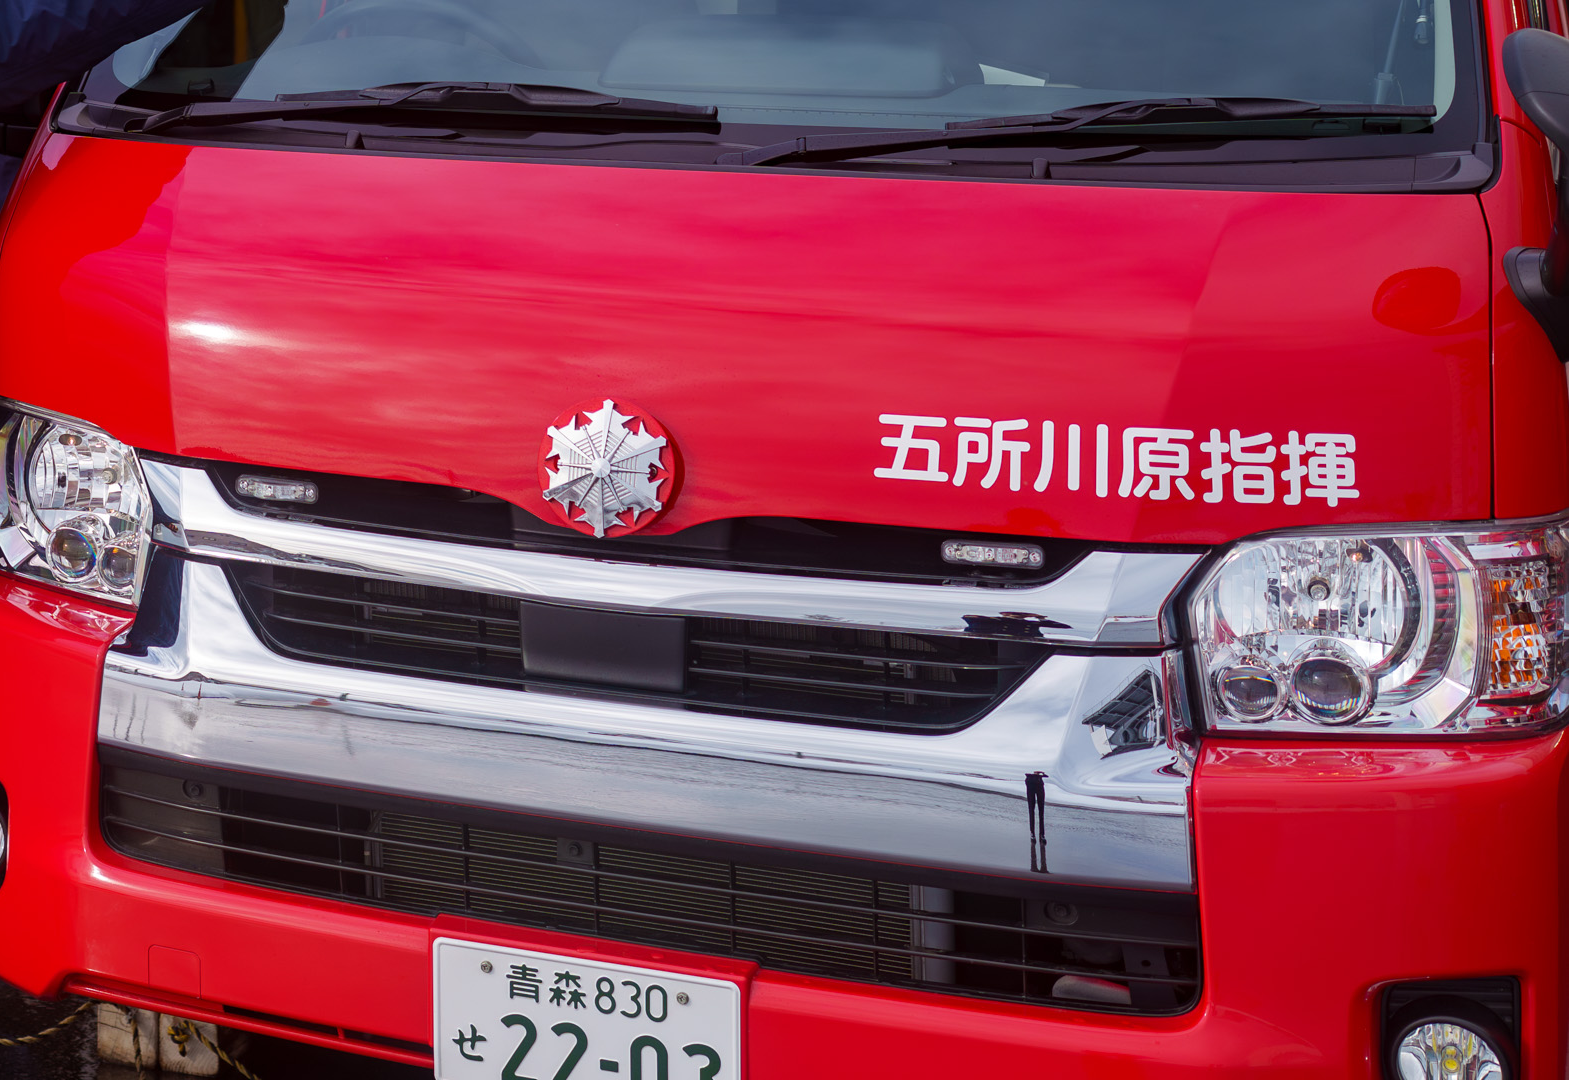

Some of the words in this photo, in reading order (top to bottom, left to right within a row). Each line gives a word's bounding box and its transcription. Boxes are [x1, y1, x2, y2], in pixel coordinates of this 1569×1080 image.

[873, 413, 1361, 508] 五所川原指揮
[451, 1023, 487, 1062] せ
